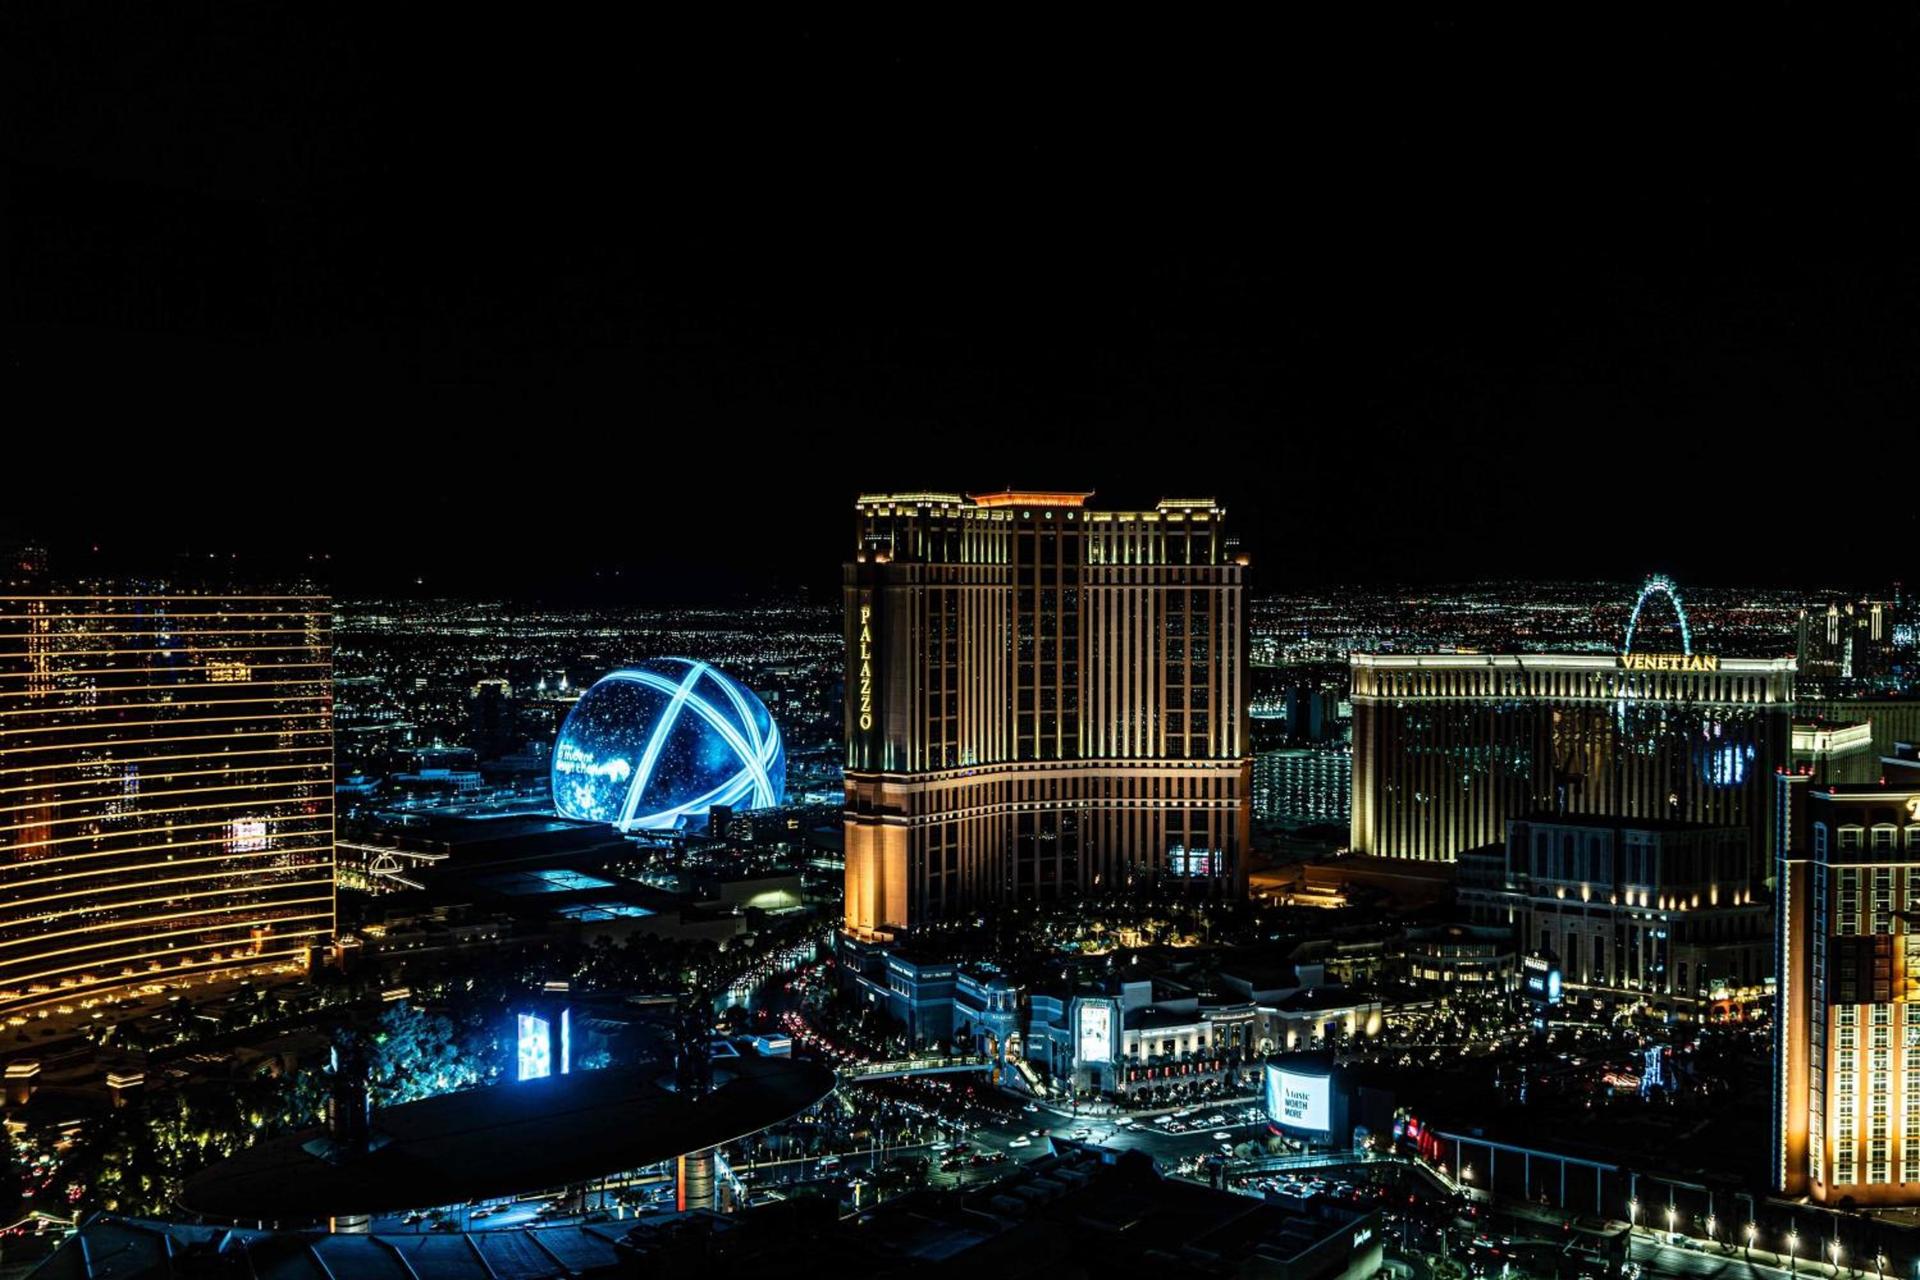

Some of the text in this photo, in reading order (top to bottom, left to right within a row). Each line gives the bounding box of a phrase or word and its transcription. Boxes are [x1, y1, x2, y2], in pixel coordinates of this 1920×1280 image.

[860, 605, 872, 731] PALAZZO
[1622, 654, 1718, 672] VENETIAN
[1285, 1098, 1308, 1111] WORTH
[1285, 1107, 1303, 1119] MORE
